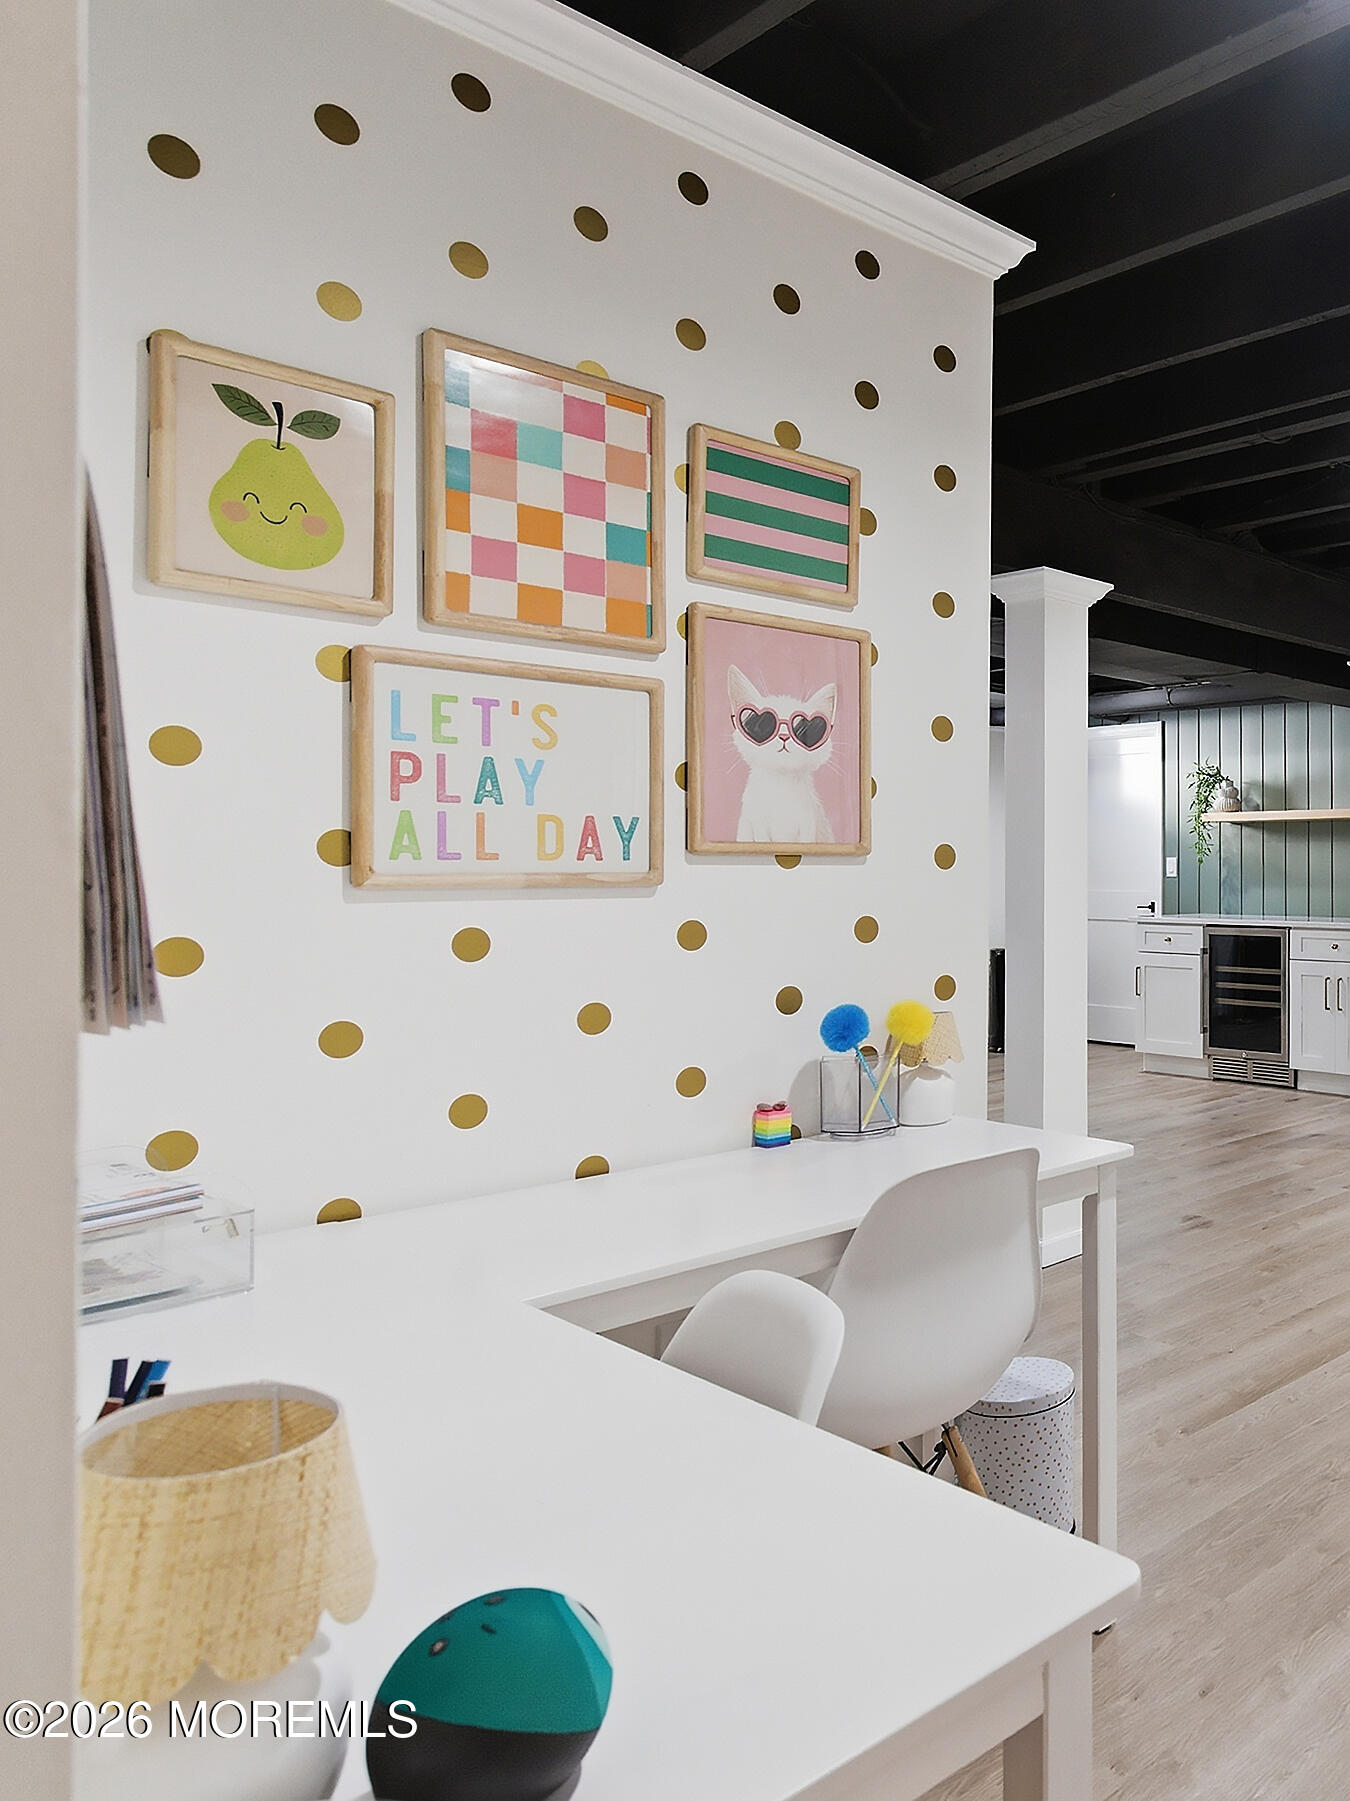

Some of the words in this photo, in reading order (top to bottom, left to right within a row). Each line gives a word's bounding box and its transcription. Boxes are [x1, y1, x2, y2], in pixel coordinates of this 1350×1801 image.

[390, 689, 559, 751] LET'S
[389, 751, 545, 807] PLAY
[389, 809, 500, 862] ALL
[536, 812, 640, 863] DAY
